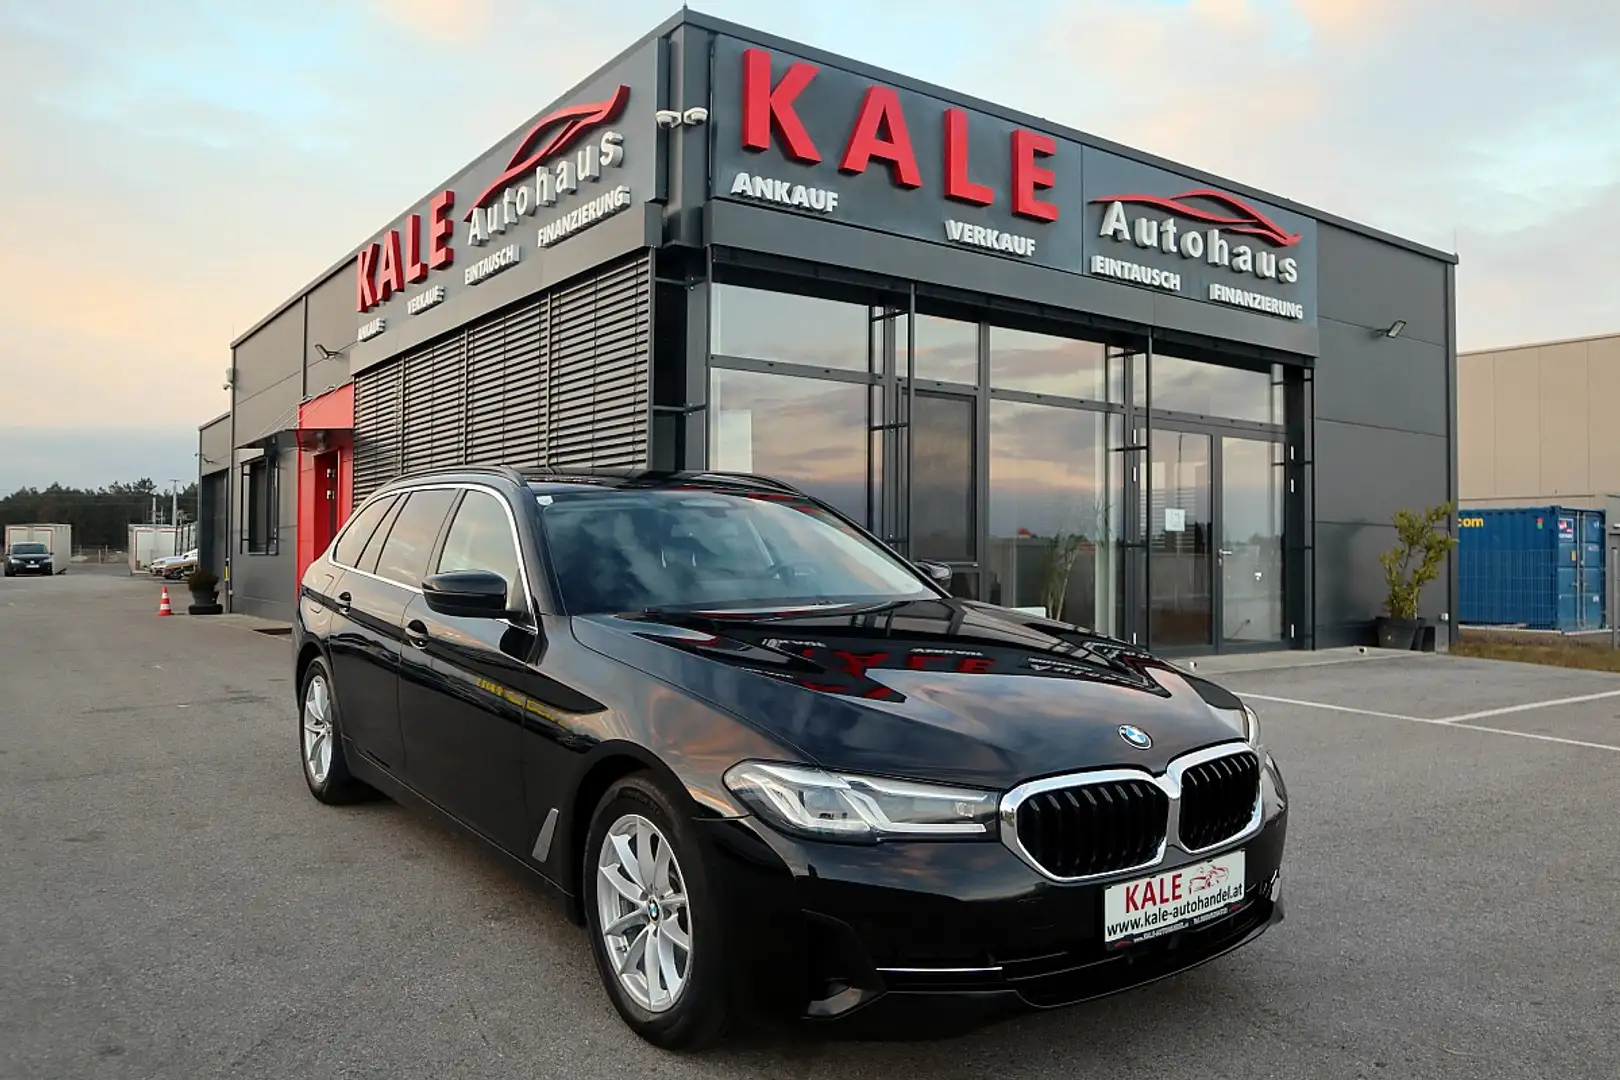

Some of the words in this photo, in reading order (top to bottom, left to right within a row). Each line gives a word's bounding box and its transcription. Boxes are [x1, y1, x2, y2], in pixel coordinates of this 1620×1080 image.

[356, 190, 454, 313] KALE
[467, 131, 624, 246] Autohaus
[741, 47, 1058, 222] KALE
[1100, 201, 1298, 284] Autohaus
[407, 285, 445, 315] VERKAUF
[464, 243, 520, 286] EINTAUSCH
[537, 184, 632, 248] FINANZIERUNG
[730, 172, 838, 213] ANKAUF
[944, 219, 1036, 257] VERKAUF
[1090, 255, 1181, 291] EINTAUSCH
[1209, 283, 1304, 320] FINANZIERUNG
[1107, 883, 1243, 937] www.kale-autohandel.at
[1125, 873, 1183, 914] KALE
